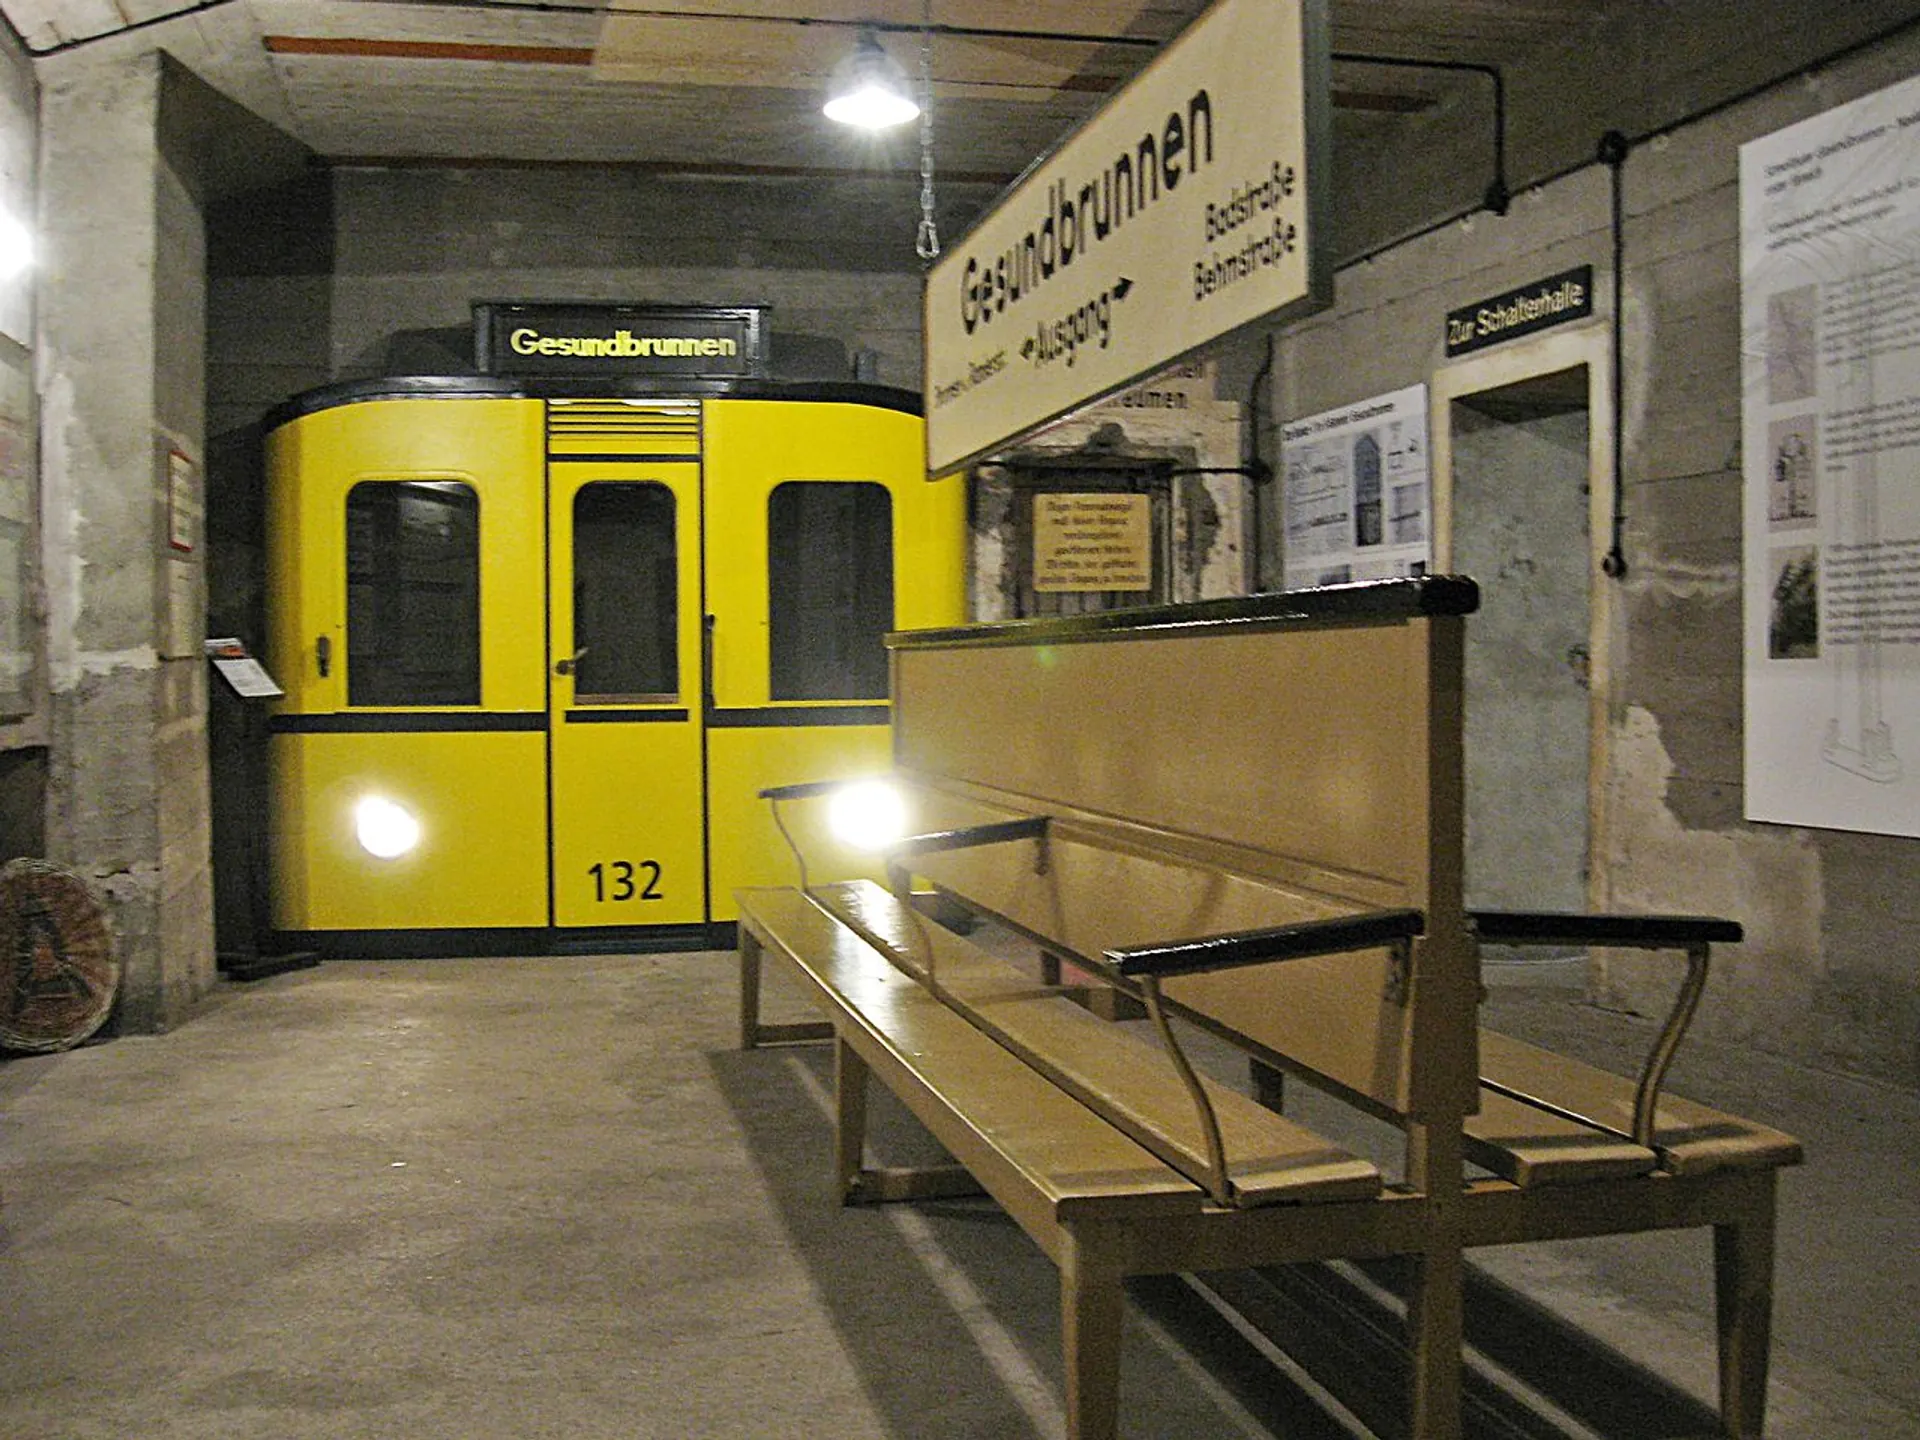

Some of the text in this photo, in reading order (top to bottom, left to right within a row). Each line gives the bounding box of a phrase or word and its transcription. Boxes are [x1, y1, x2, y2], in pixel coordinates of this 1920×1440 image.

[961, 88, 1213, 336] Gesundbrunnen
[1205, 160, 1295, 242] Badstraße
[1193, 216, 1296, 301] Behmstraße
[510, 328, 737, 357] Gesundbrunnen
[1035, 292, 1112, 368] Ausgang
[1448, 280, 1585, 346] Zur Schalterhalle
[588, 860, 663, 902] 132
